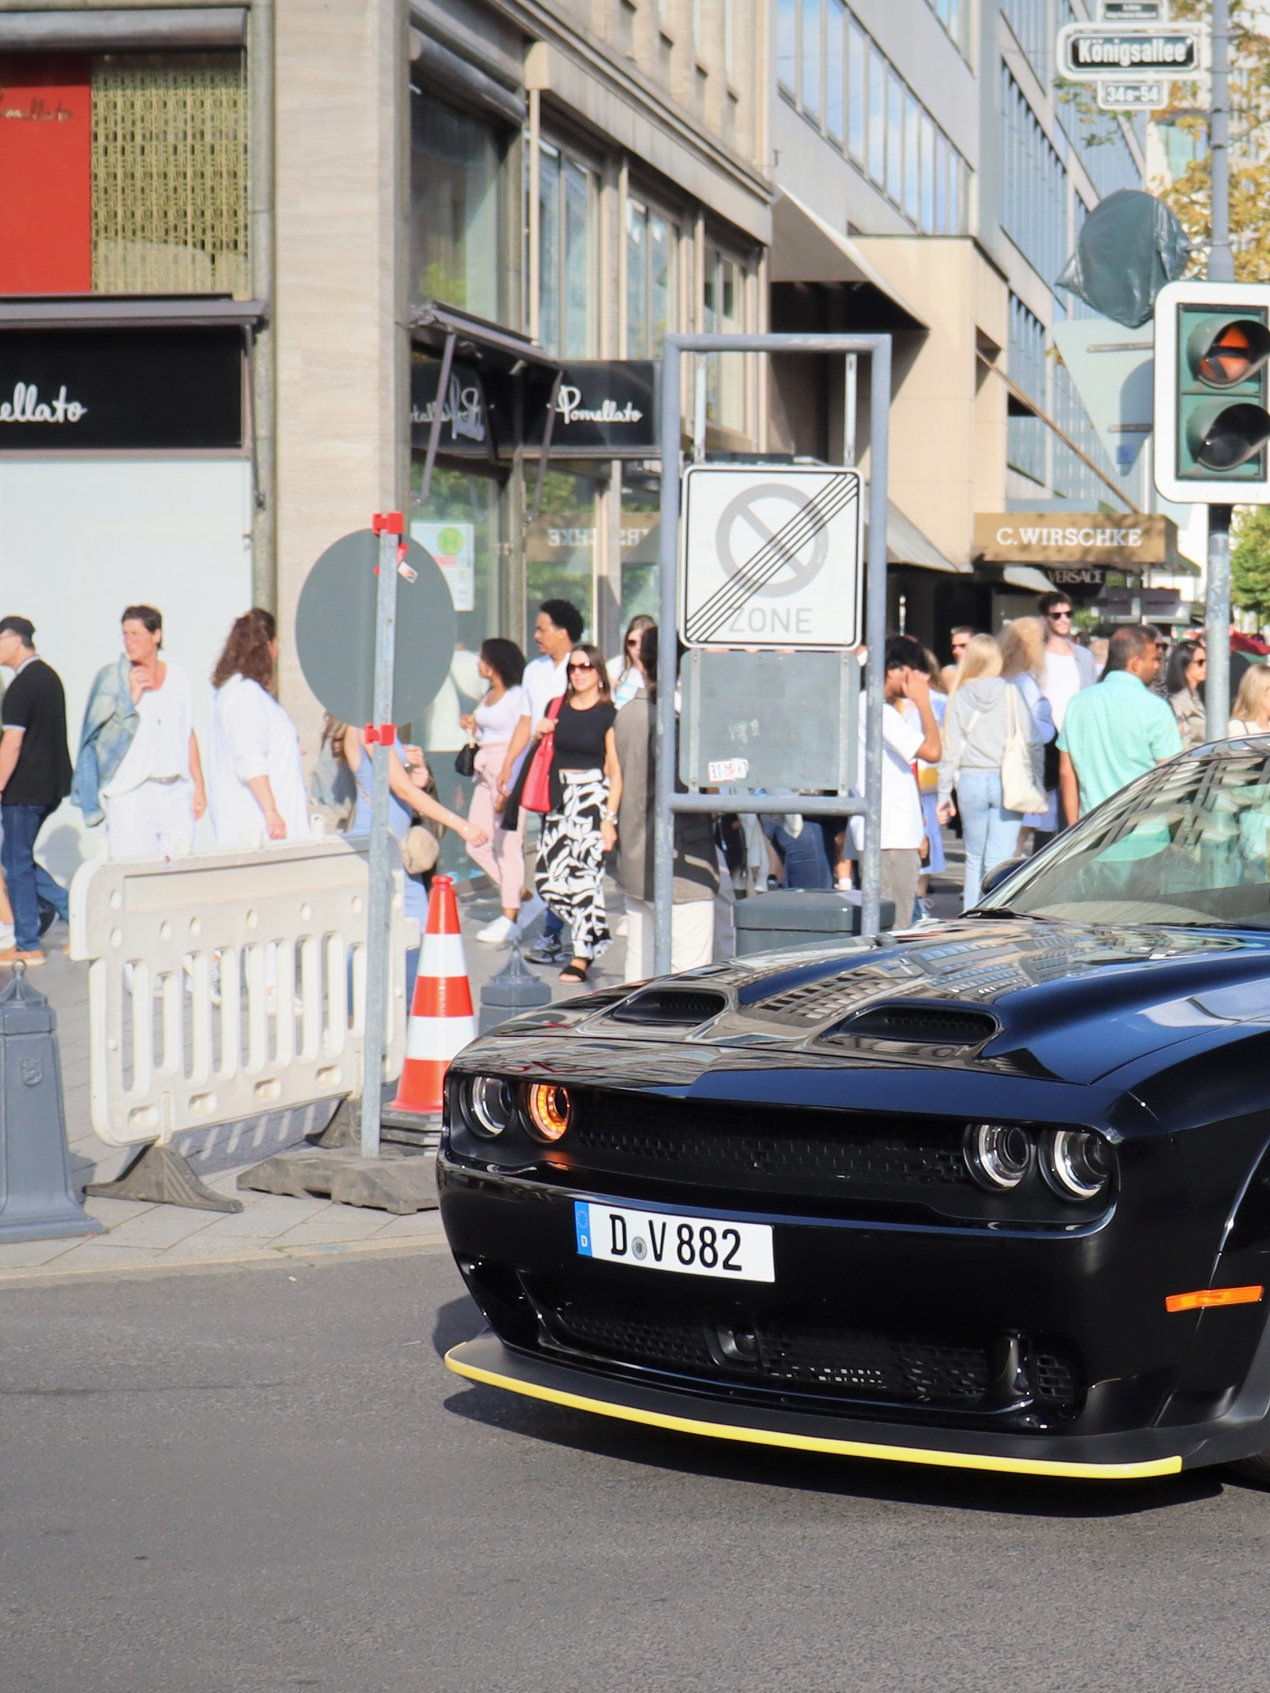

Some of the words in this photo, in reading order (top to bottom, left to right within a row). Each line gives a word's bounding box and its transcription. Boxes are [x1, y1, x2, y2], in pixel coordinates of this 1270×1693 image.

[1078, 38, 1186, 67] Königsallee
[1107, 86, 1159, 102] 34a-54
[548, 385, 643, 424] Pomellato
[996, 527, 1143, 547] C.WIRSCHKE
[728, 607, 813, 634] ZONE
[581, 1235, 588, 1248] D
[609, 1214, 627, 1256] D
[648, 1219, 667, 1262] V
[676, 1223, 743, 1271] 882
